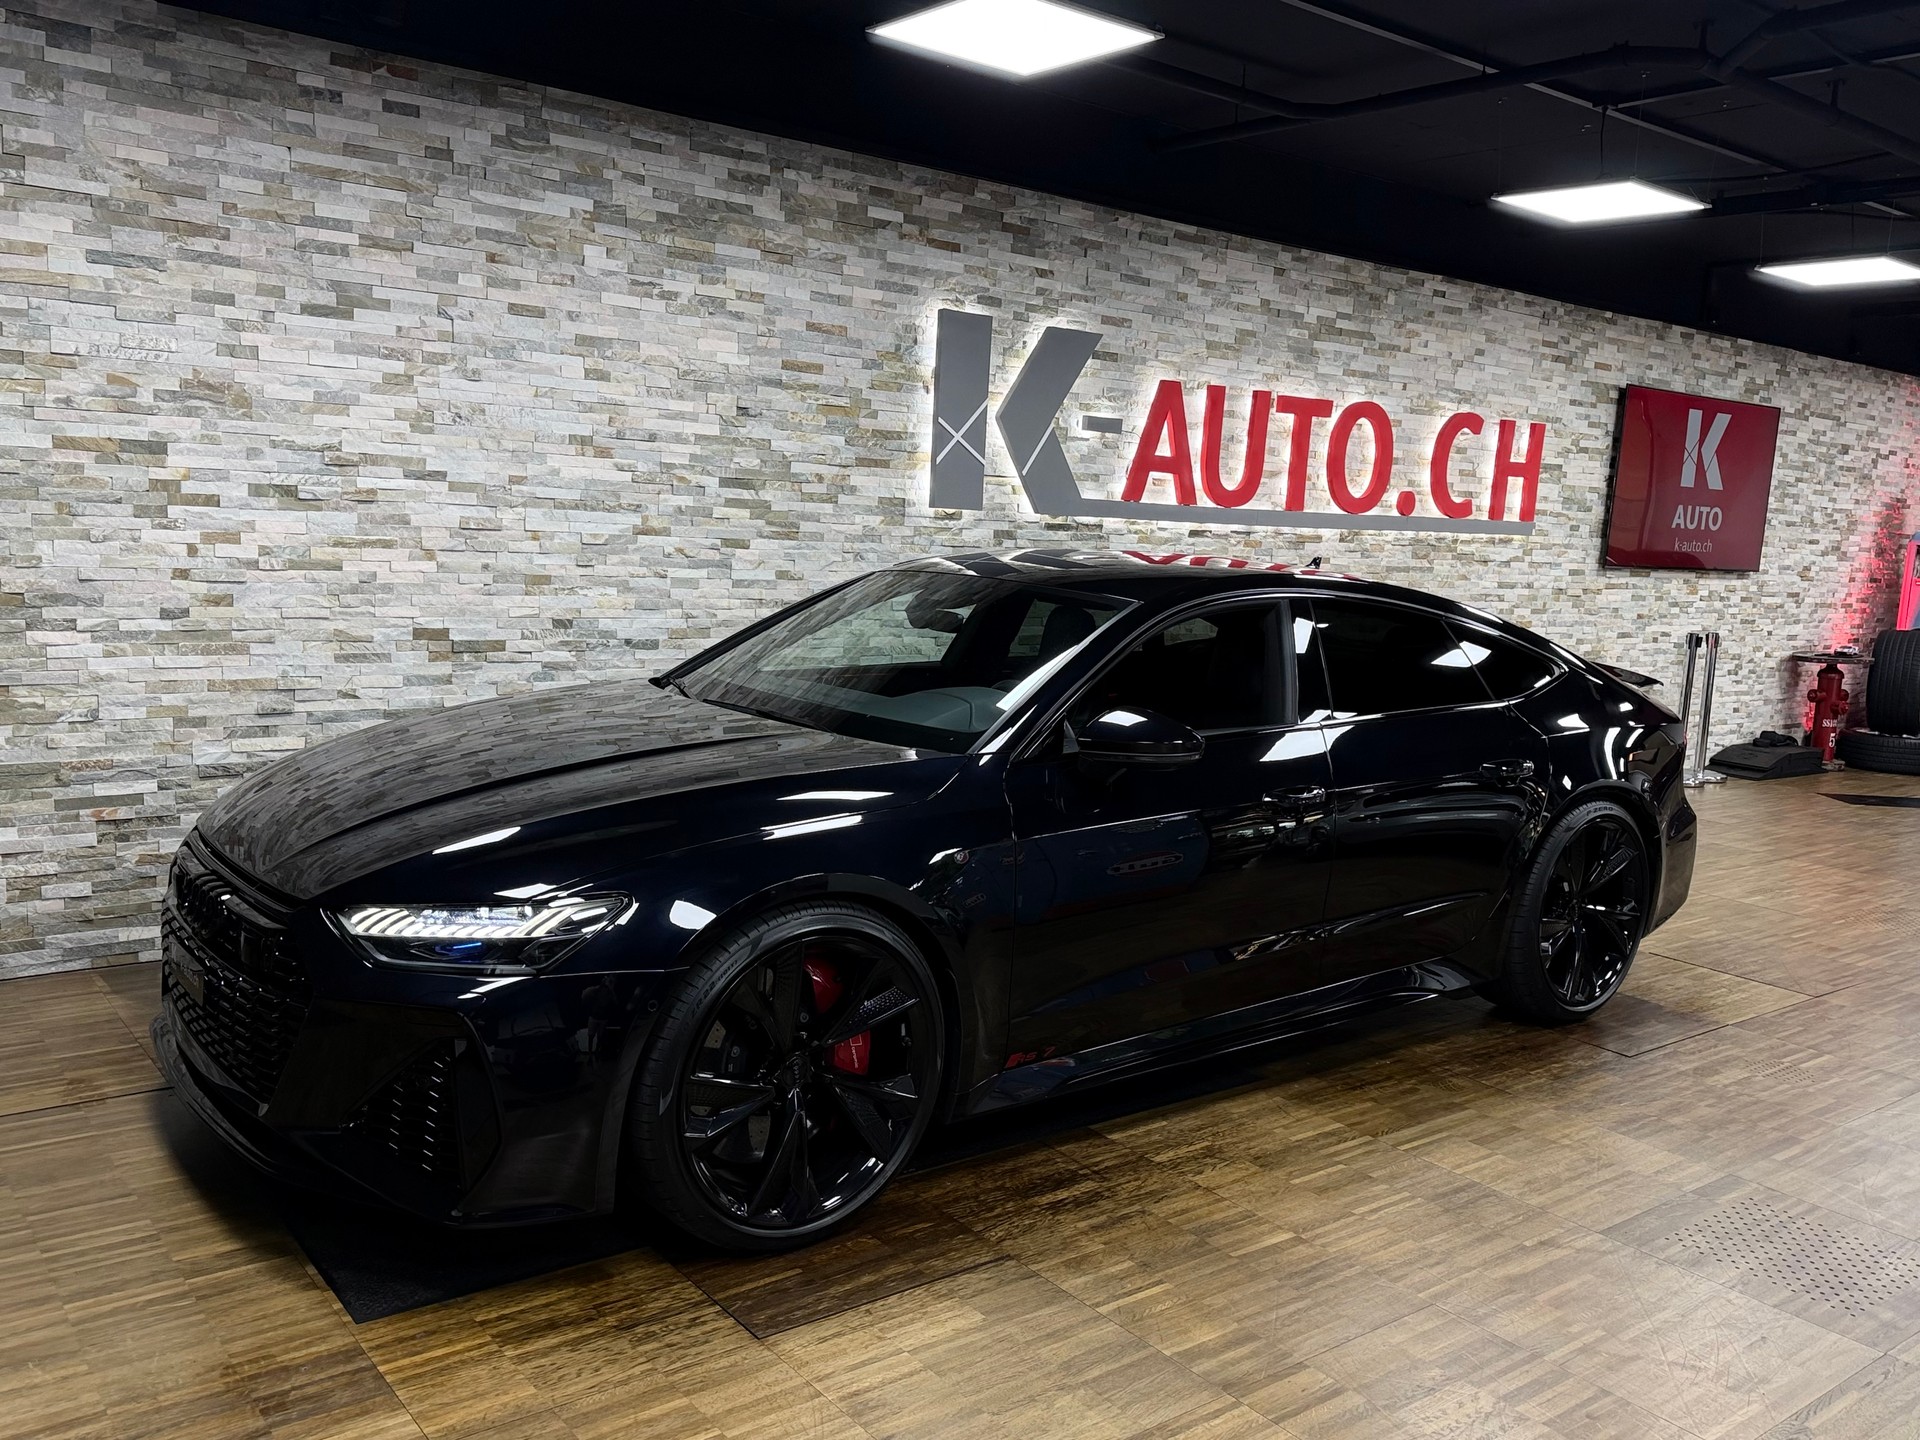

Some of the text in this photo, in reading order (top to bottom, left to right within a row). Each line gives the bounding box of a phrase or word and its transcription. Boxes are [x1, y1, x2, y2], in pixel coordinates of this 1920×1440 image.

[1680, 408, 1732, 490] K
[1671, 504, 1723, 531] AUTO
[1674, 537, 1713, 553] k-auto.ch
